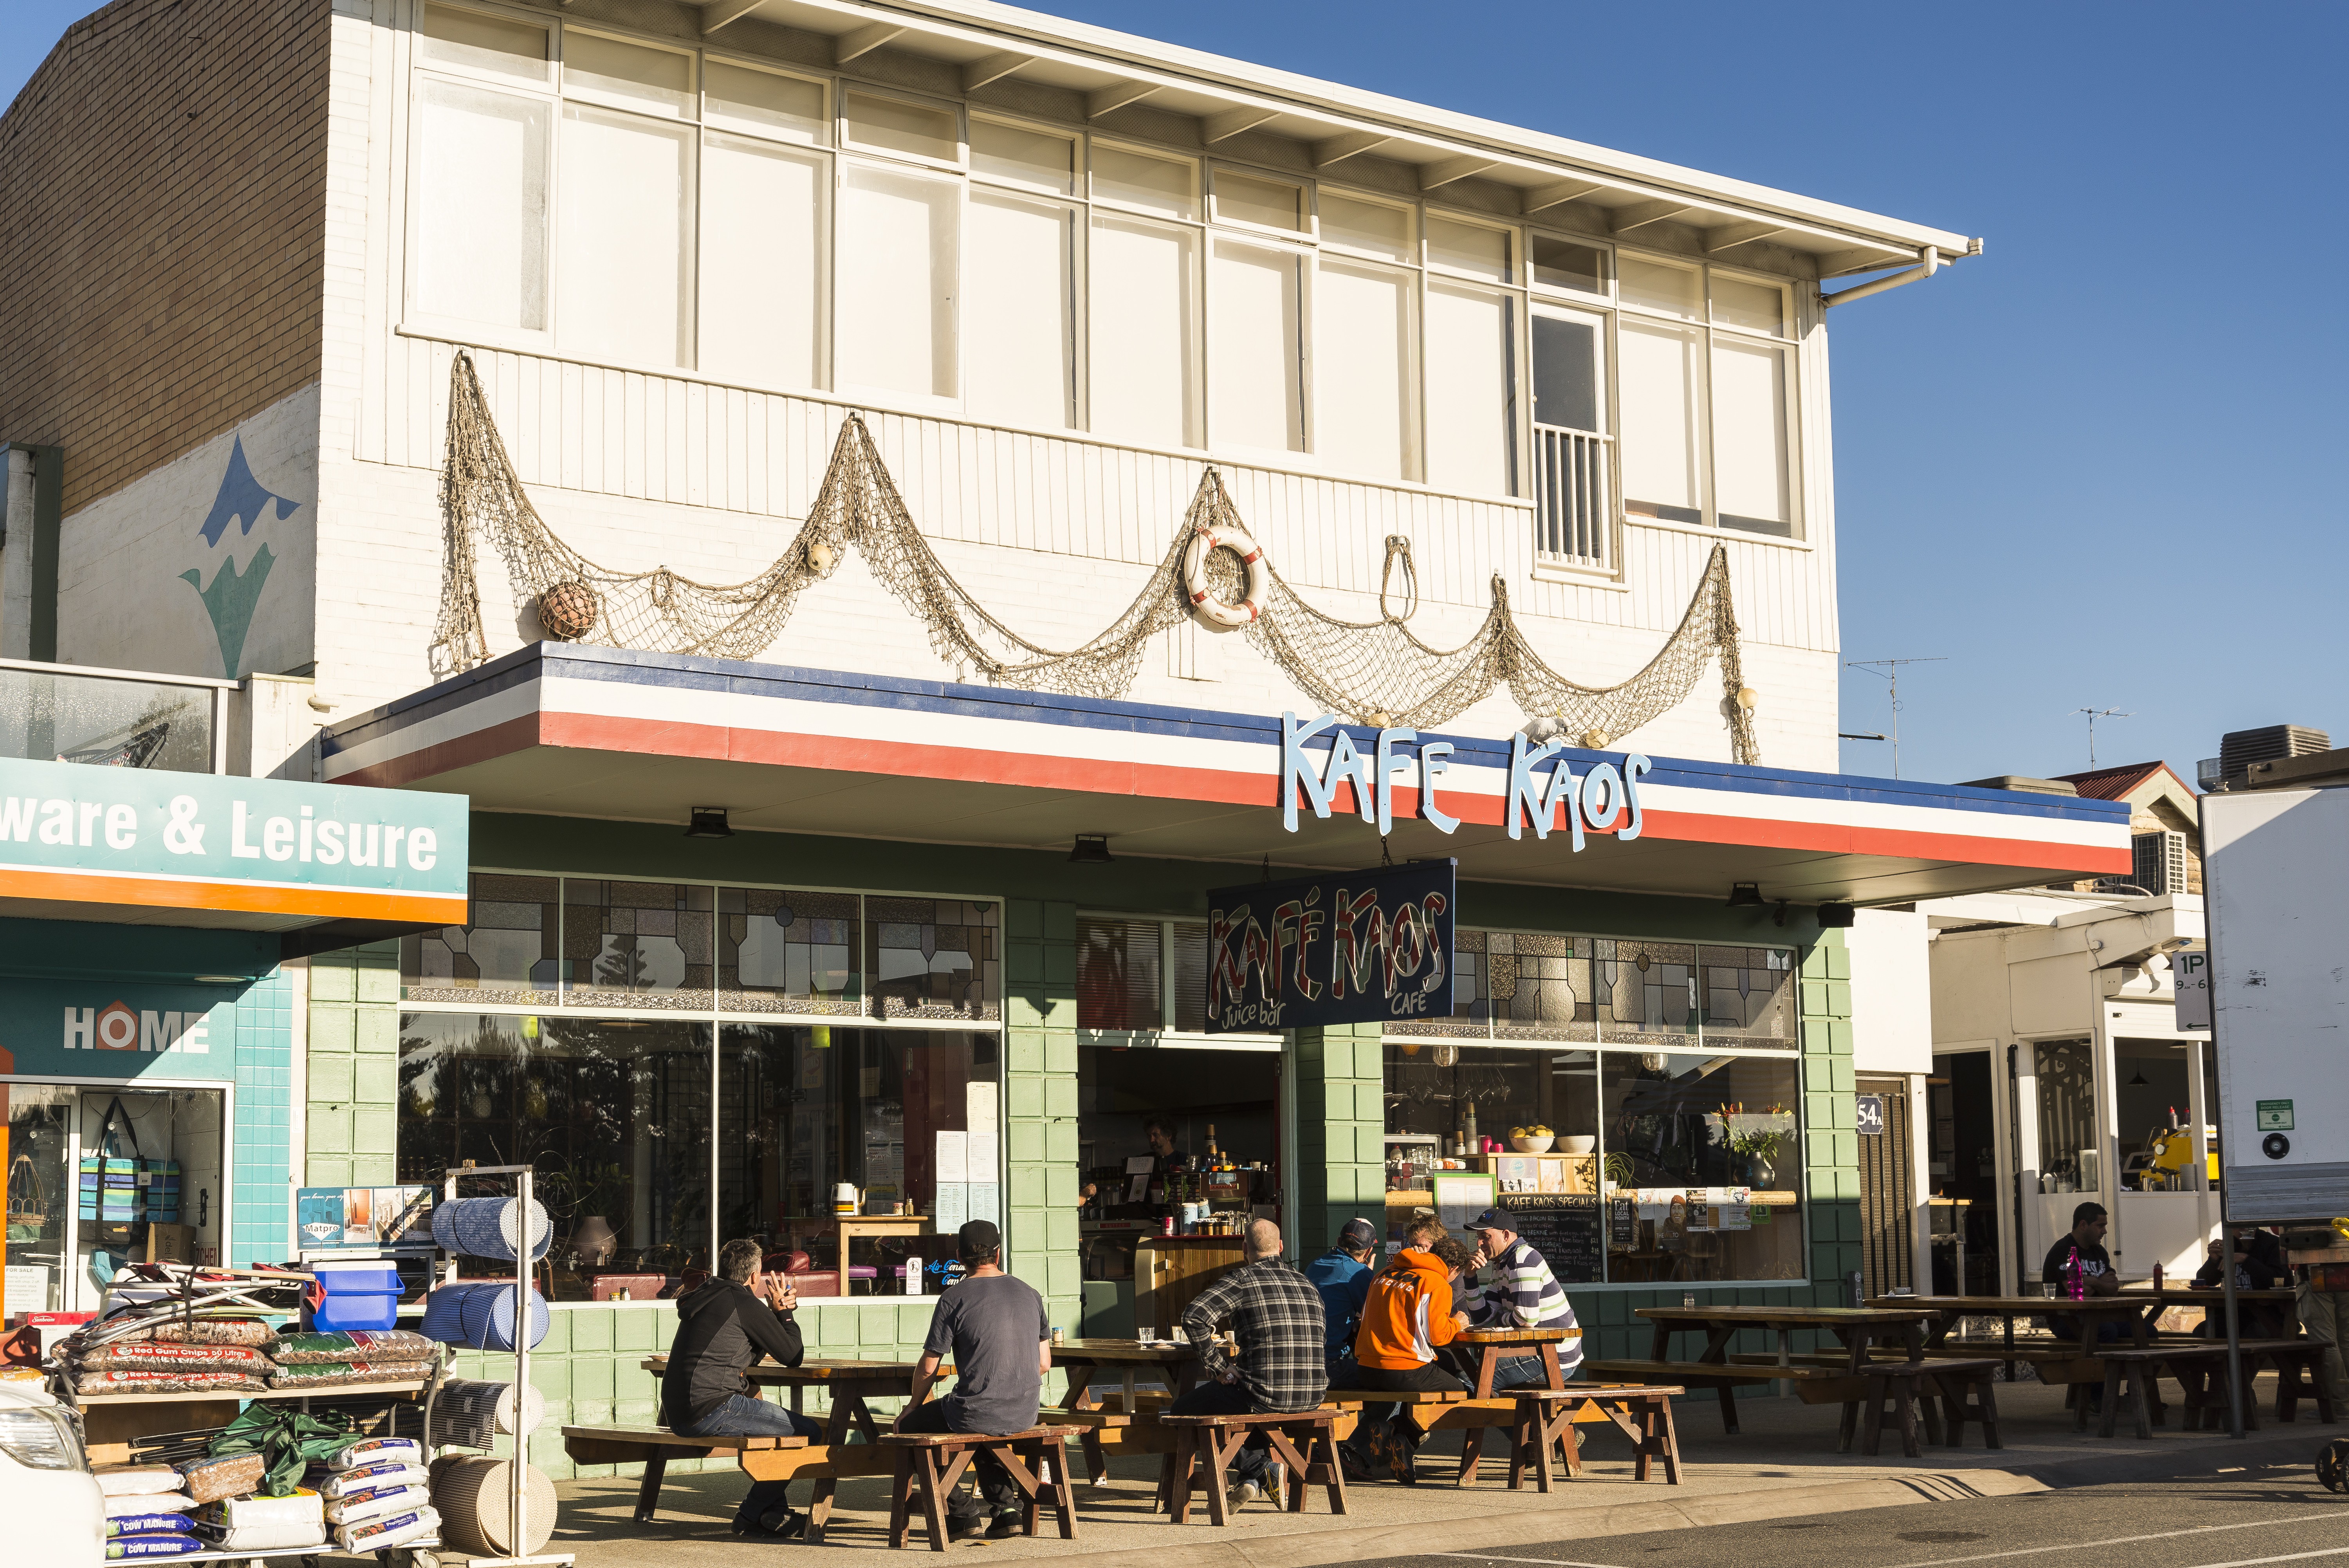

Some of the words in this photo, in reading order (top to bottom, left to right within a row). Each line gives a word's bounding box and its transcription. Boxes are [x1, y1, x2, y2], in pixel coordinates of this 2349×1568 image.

[1283, 711, 1461, 835] KAFE
[1508, 731, 1651, 853] KAOS
[163, 794, 207, 855] &
[231, 800, 437, 871] Leisure
[1333, 888, 1447, 1000] KAOS
[2181, 955, 2205, 974] 1P
[1222, 1005, 1256, 1030] Juice
[1259, 1001, 1286, 1026] bar
[63, 1006, 209, 1054] HOME
[1858, 1104, 1882, 1125] 54A
[1507, 1196, 1531, 1211] KAFE
[1557, 1196, 1597, 1208] SPECIALS
[1614, 1200, 1629, 1211] Eat
[305, 1225, 338, 1233] Matpro
[924, 1259, 942, 1274] Air
[123, 1520, 143, 1531] COW
[143, 1519, 176, 1529] MANURE
[386, 1517, 406, 1527] Premium
[127, 1543, 148, 1554] COW
[148, 1543, 182, 1553] MANURE
